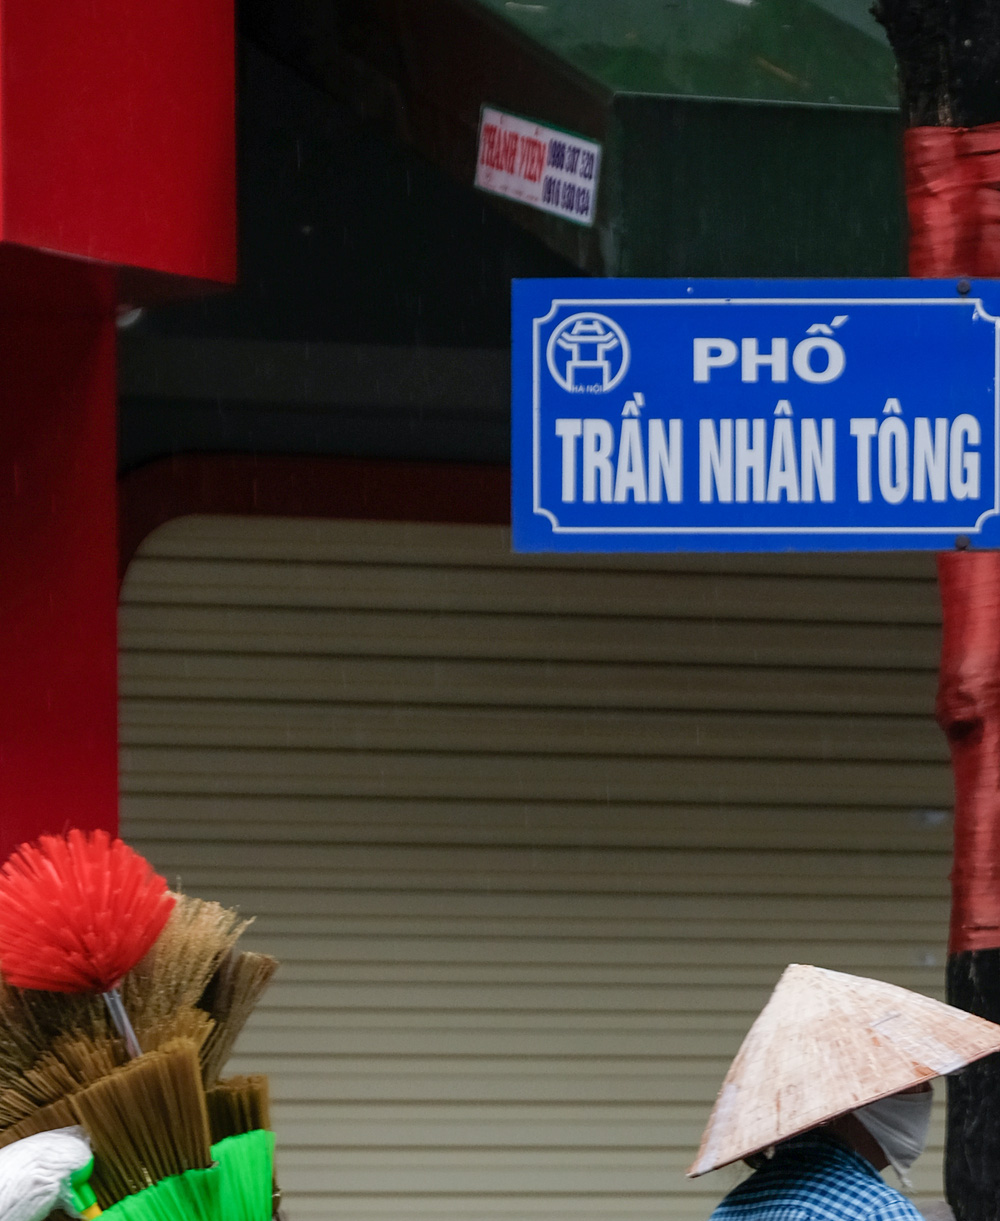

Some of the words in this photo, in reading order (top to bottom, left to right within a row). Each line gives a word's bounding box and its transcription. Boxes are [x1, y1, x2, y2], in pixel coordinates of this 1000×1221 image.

[692, 315, 849, 384] PHỐ
[555, 392, 682, 505] TRẦN
[699, 399, 835, 504] NHÂN
[849, 397, 981, 504] TÔNG
